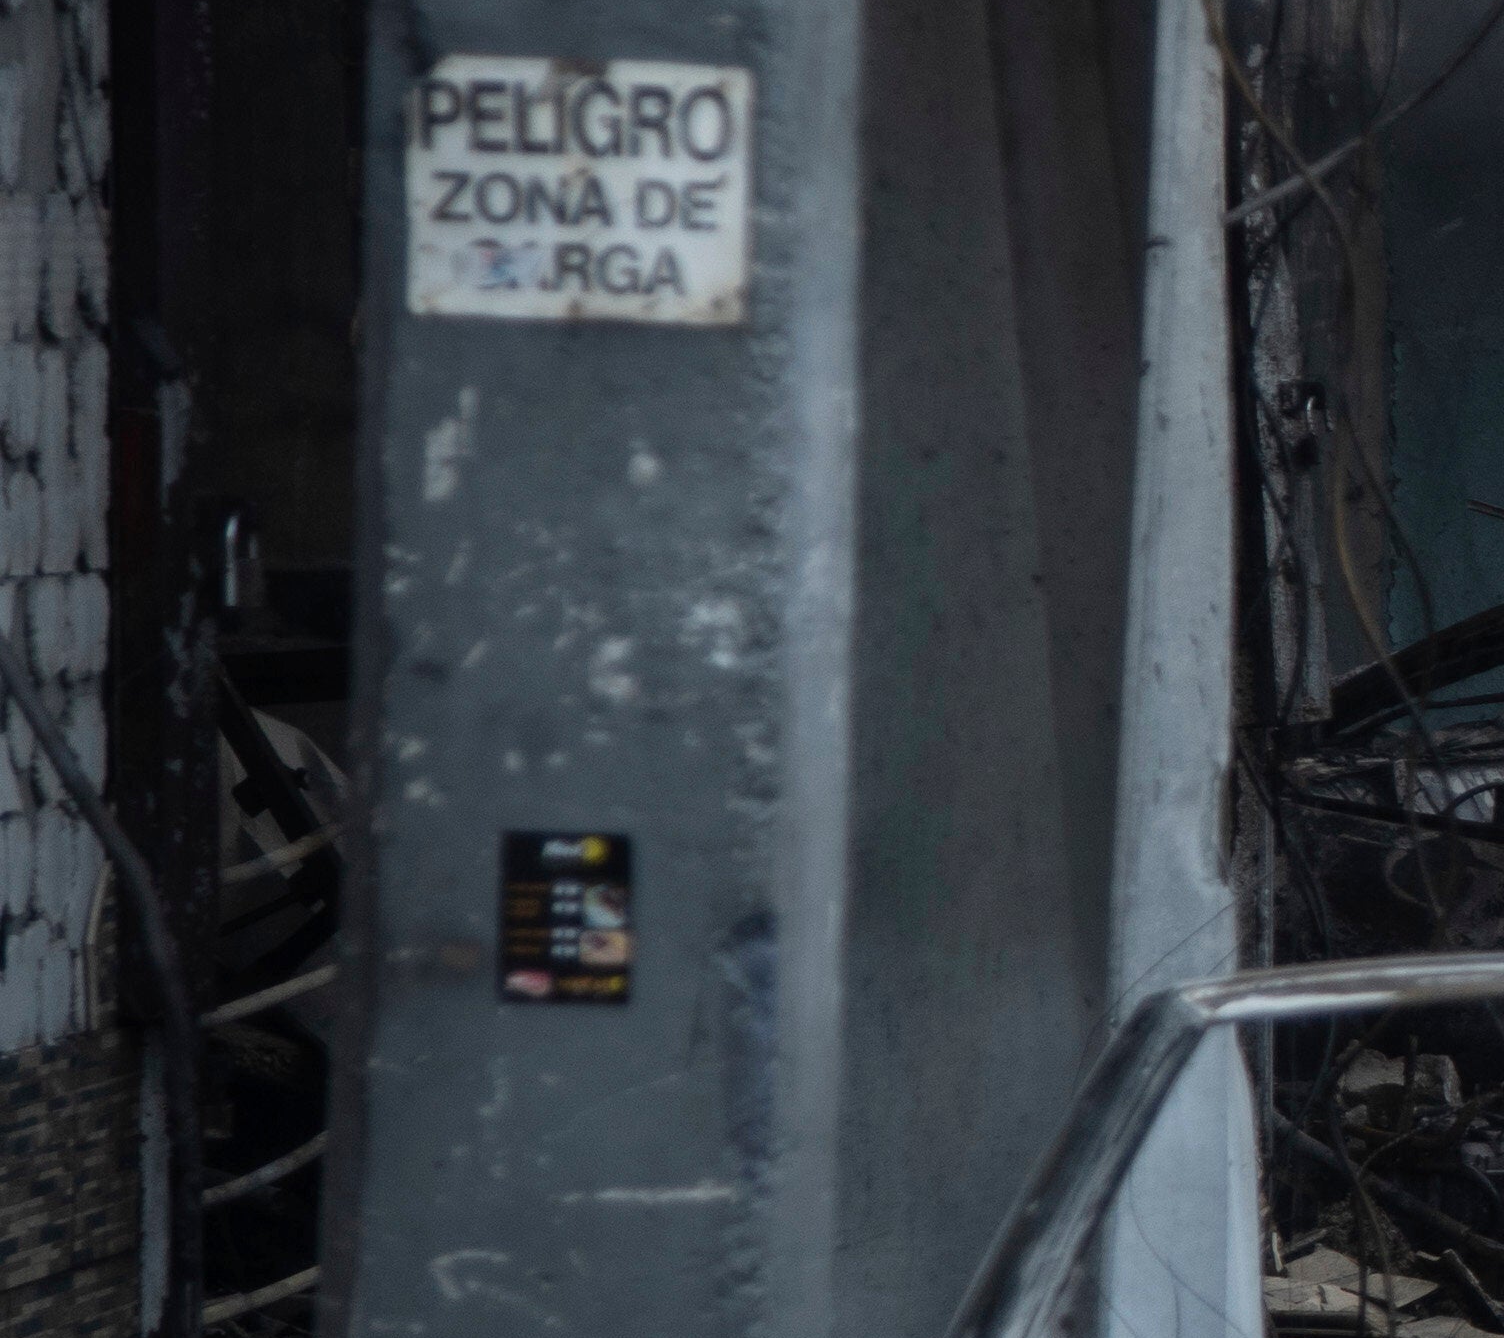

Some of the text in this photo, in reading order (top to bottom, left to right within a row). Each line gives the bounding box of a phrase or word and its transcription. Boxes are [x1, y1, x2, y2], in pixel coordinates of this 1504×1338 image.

[419, 78, 736, 162] PELIGRO
[430, 169, 724, 231] ZONA DE
[465, 241, 686, 296] RGA
